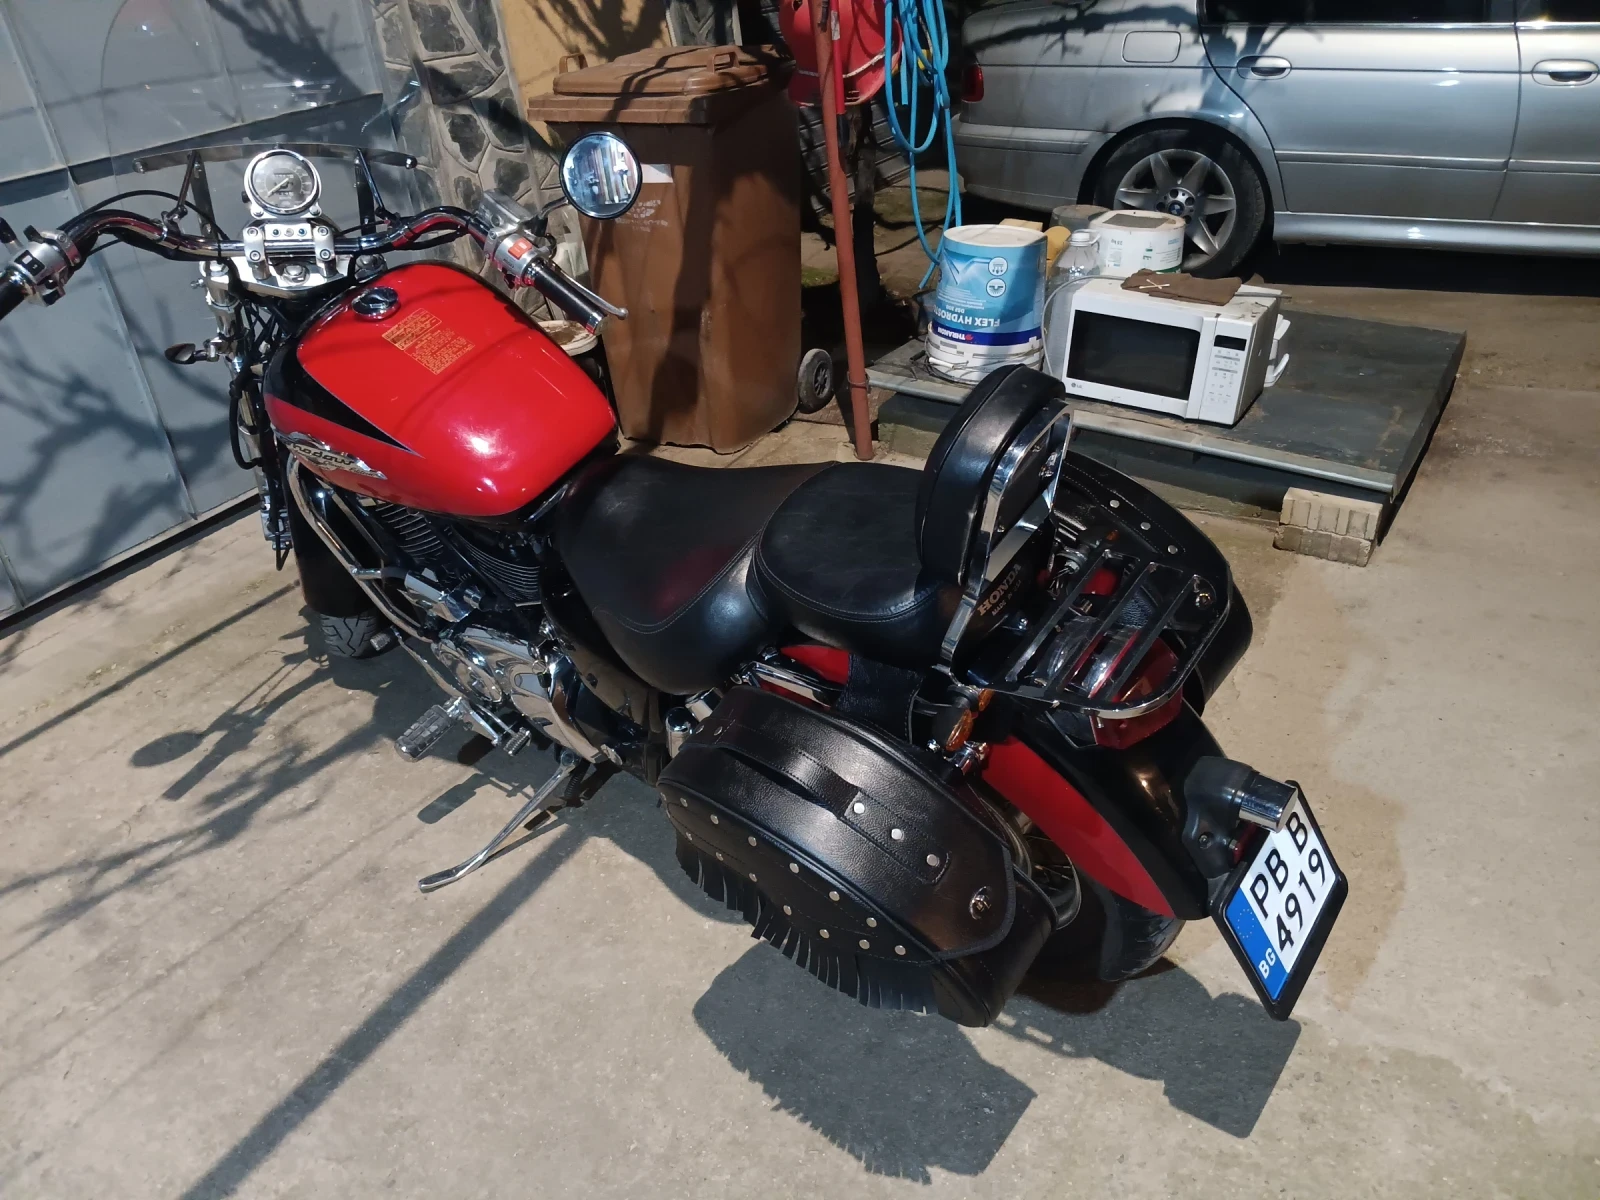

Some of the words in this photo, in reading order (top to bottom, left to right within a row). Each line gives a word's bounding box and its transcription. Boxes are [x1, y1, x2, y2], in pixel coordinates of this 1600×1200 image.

[974, 316, 1001, 327] FLEX
[977, 564, 1022, 616] HONDA
[1249, 848, 1288, 919] PB
[1285, 811, 1308, 854] B
[1276, 848, 1326, 952] 4919
[1258, 947, 1276, 979] BG
